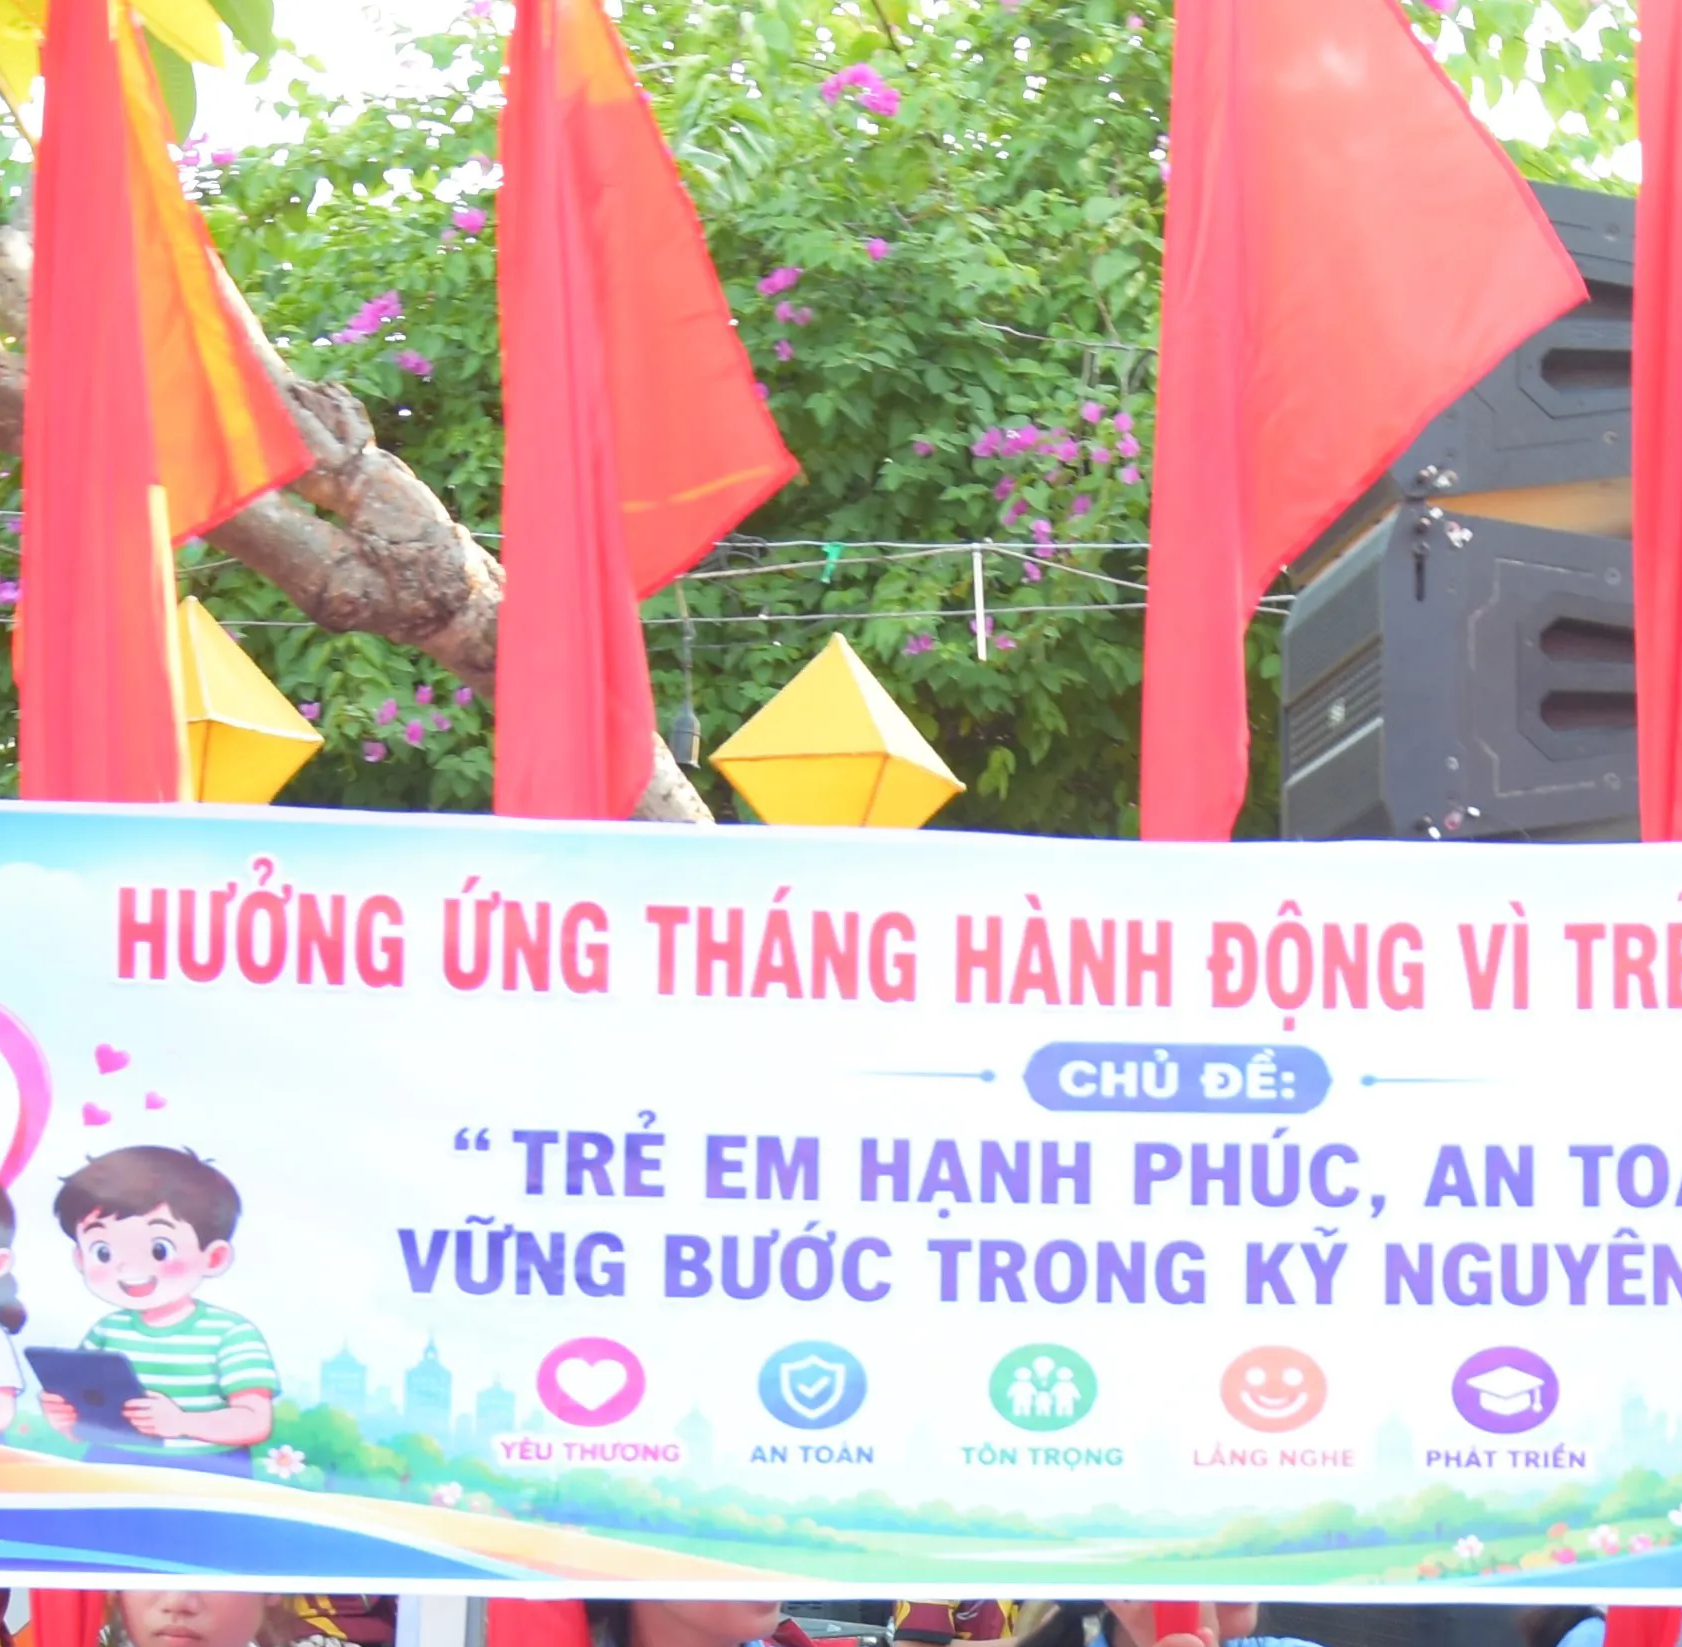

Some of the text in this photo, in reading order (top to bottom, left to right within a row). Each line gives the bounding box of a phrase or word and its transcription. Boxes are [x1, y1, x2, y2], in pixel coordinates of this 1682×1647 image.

[116, 856, 406, 990] HƯỞNG
[441, 874, 611, 996] ỨNG
[644, 884, 918, 1004] THÁNG
[954, 892, 1174, 1009] HÀNH
[1205, 898, 1426, 1033] ĐỘNG
[1457, 899, 1530, 1011] VÌ
[1057, 1047, 1297, 1101] CHỦ ĐỀ:
[704, 1133, 821, 1202] EM
[859, 1136, 1092, 1220] HẠNH
[1132, 1126, 1387, 1220] PHÚC,
[1422, 1143, 1535, 1209] AN
[395, 1213, 627, 1299] VỮNG
[663, 1219, 893, 1304] BƯỚC
[926, 1238, 1207, 1306] TRONG
[1244, 1225, 1349, 1306] KỸ
[499, 1436, 681, 1464] YÊU THƯƠNG
[749, 1444, 788, 1464] AN
[1026, 1446, 1125, 1473] TRỌNG
[1278, 1448, 1357, 1468] NGHE
